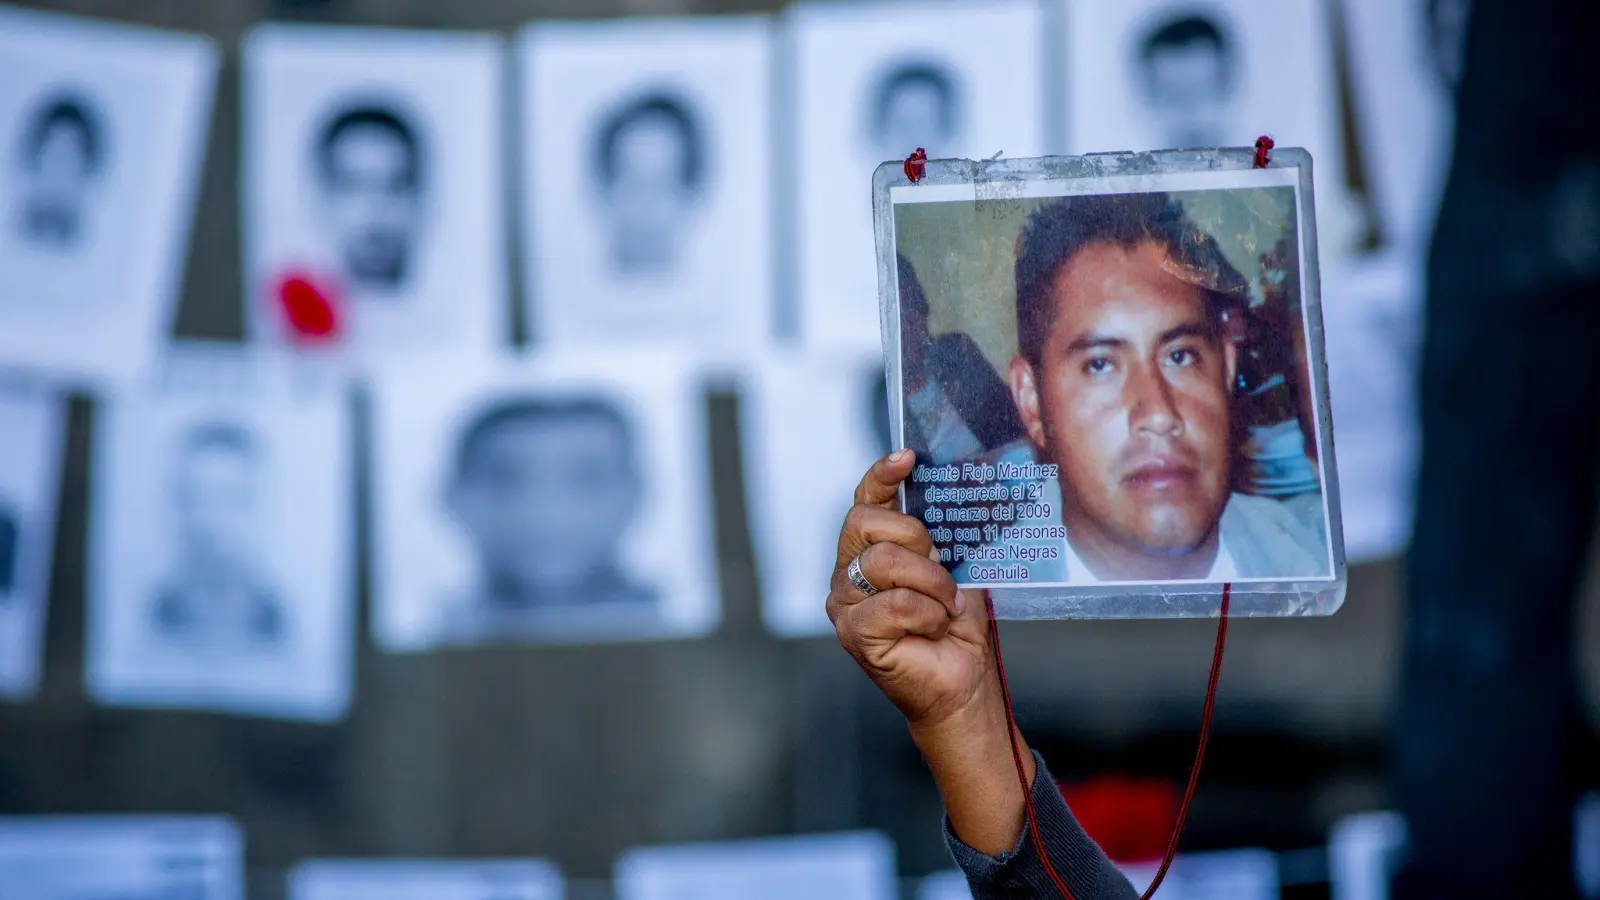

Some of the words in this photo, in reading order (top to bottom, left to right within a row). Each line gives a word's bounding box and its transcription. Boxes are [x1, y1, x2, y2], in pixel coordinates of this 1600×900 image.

[913, 464, 958, 482] Vicente
[963, 465, 994, 482] Rojo
[998, 463, 1058, 478] Martínez
[925, 486, 1009, 504] desaparecio
[1012, 486, 1024, 499] el
[1027, 484, 1044, 498] 21
[925, 507, 943, 521] de
[946, 508, 990, 521] marzo
[993, 504, 1013, 519] del
[1017, 504, 1051, 518] 2009
[928, 527, 951, 541] nto
[954, 530, 980, 541] con
[984, 525, 998, 541] 11
[1003, 526, 1066, 542] personas
[937, 548, 951, 561] n
[954, 546, 1005, 560] Piedras
[1009, 545, 1058, 562] Negras
[970, 565, 1028, 580] Coahuila
